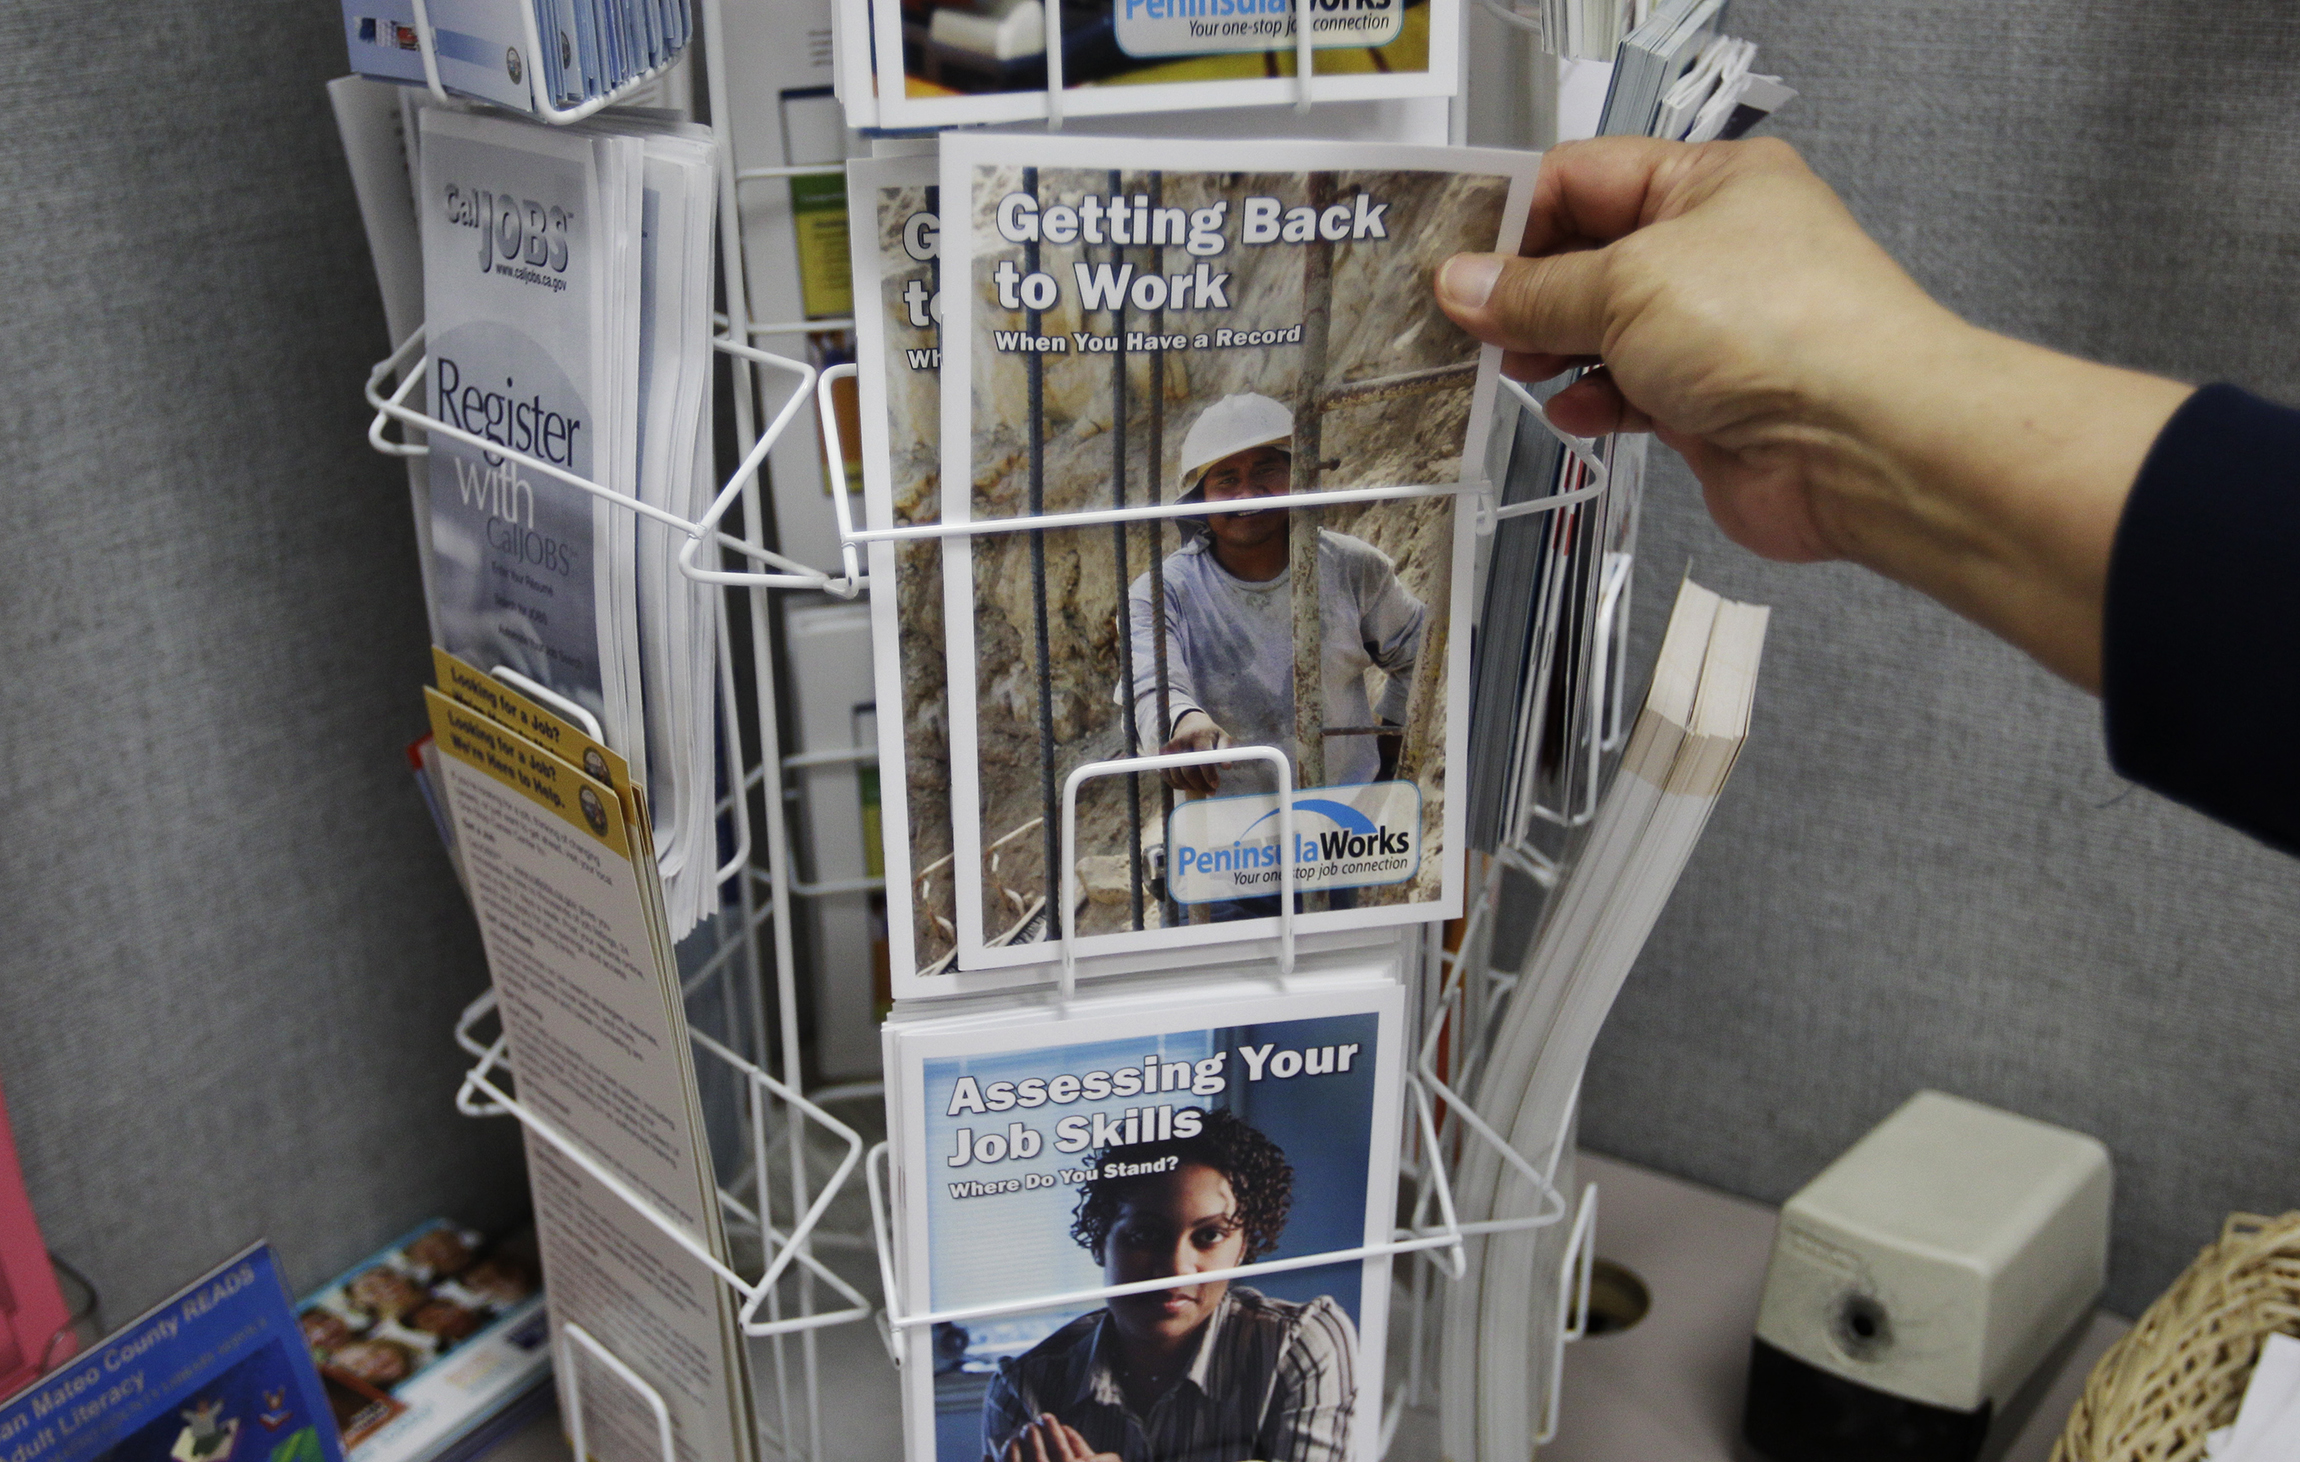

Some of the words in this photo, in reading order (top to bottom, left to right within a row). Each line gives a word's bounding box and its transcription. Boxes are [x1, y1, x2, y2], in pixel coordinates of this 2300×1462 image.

[1189, 20, 1219, 37] Your
[1222, 20, 1282, 37] one-stop
[1313, 13, 1389, 31] connection
[997, 193, 1227, 255] Getting
[1242, 194, 1388, 243] Back
[496, 264, 567, 293] www.caljobs.ca.gov
[995, 259, 1057, 311] to
[1074, 263, 1228, 311] Work
[995, 329, 1066, 353] When
[1074, 332, 1120, 353] You
[1127, 331, 1187, 352] Have
[1193, 334, 1208, 349] a
[1216, 325, 1301, 347] Record
[437, 357, 580, 467] Register
[455, 461, 534, 529] with
[487, 516, 570, 576] CalJOBS
[451, 666, 498, 709] Looking
[500, 694, 517, 717] for
[520, 711, 528, 724] a
[532, 715, 560, 743] Job?
[447, 709, 496, 749] Looking
[497, 737, 514, 757] for
[518, 751, 526, 764] a
[530, 755, 556, 781] Job?
[487, 751, 515, 779] Here
[518, 769, 531, 788] to
[533, 777, 565, 808] Help.
[1234, 871, 1260, 885] Your
[1317, 862, 1338, 880] job
[1342, 857, 1408, 874] connection
[948, 1051, 1227, 1117] Assessing
[1239, 1043, 1360, 1082] Your
[948, 1122, 1042, 1168] Job
[1054, 1105, 1204, 1154] Skills
[949, 1177, 1021, 1199] Where
[1025, 1172, 1054, 1190] Do
[1060, 1166, 1099, 1185] You
[1103, 1155, 1180, 1179] Stand?
[32, 1367, 100, 1420] Mateo
[103, 1315, 179, 1373] County
[182, 1262, 256, 1322] READS
[58, 1369, 145, 1435] Literacy
